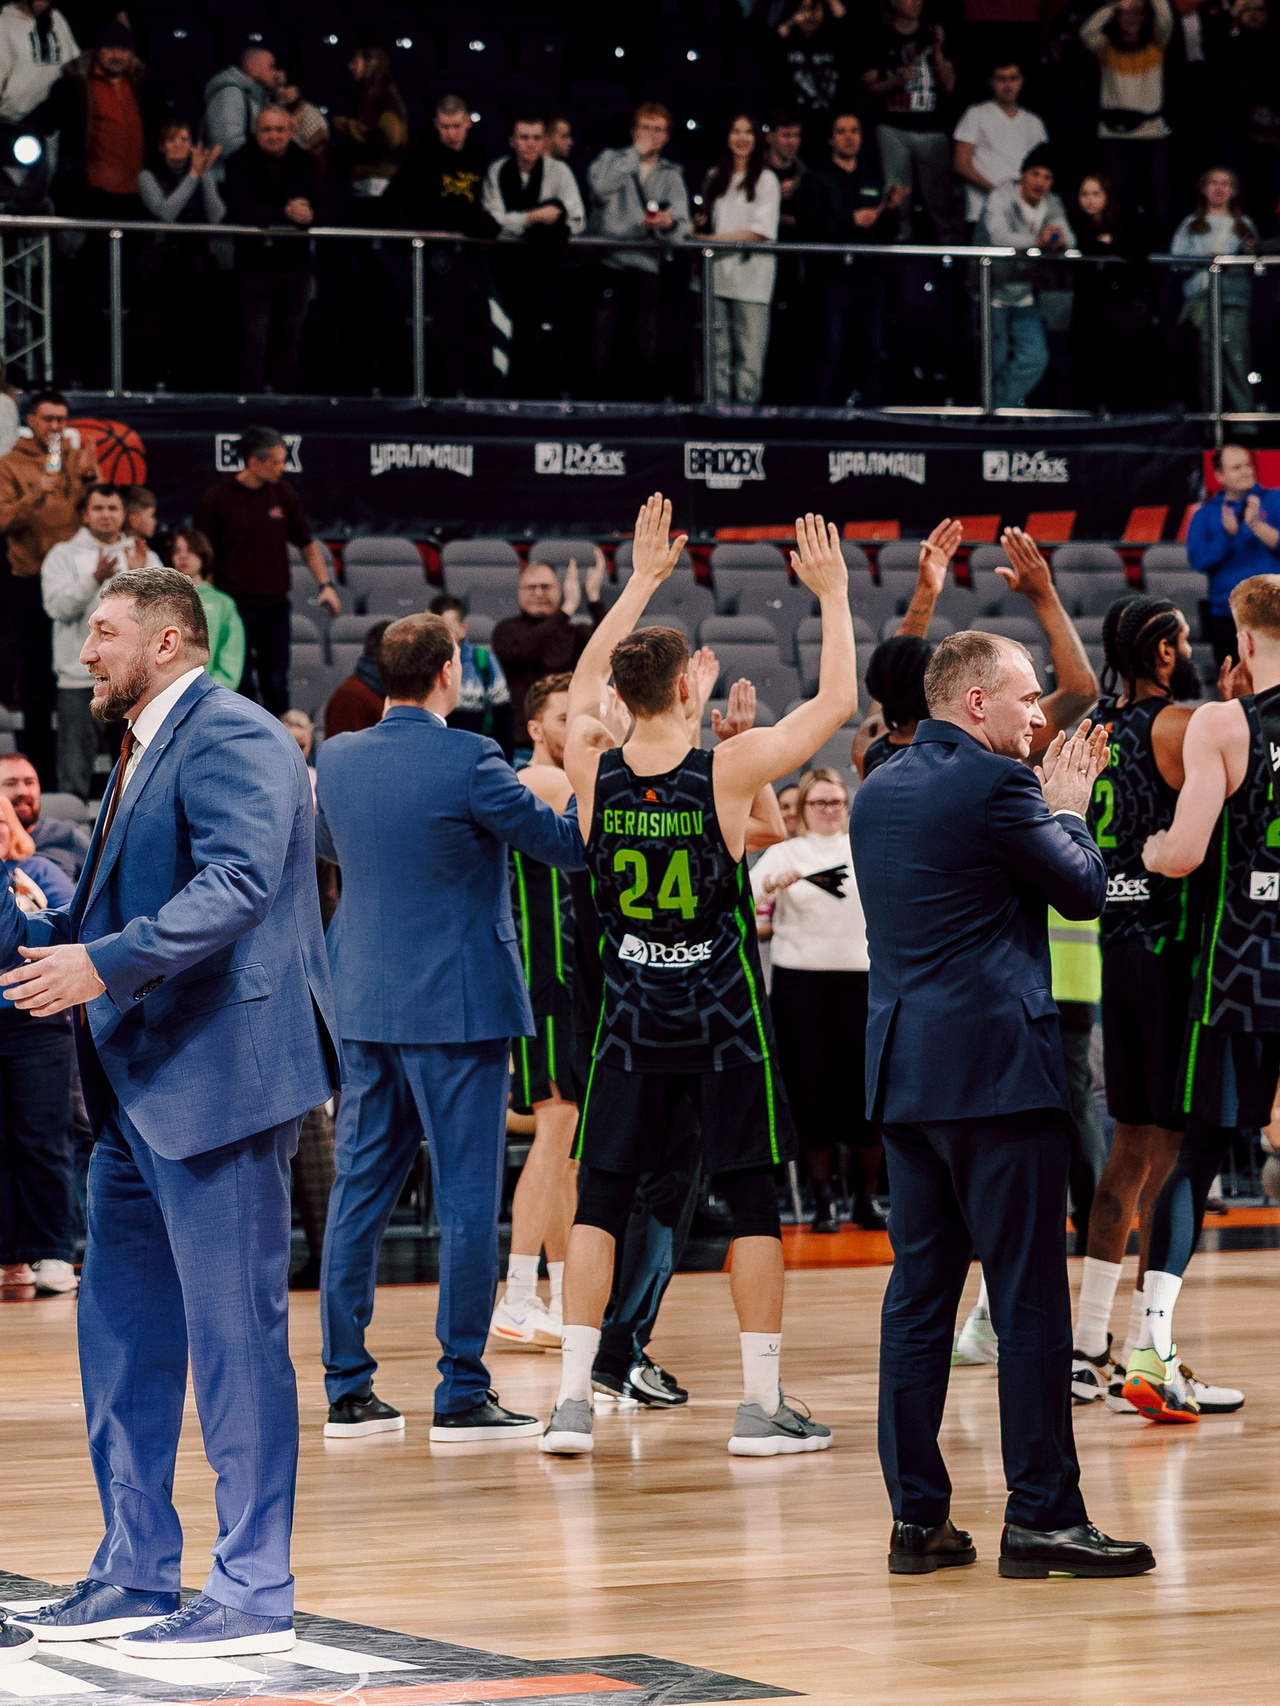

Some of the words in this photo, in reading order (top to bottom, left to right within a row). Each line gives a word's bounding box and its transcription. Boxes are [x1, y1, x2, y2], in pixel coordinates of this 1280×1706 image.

[603, 809, 704, 837] GERASIMOV
[1084, 778, 1118, 848] 2
[613, 849, 699, 920] 24
[647, 940, 713, 962] Робек
